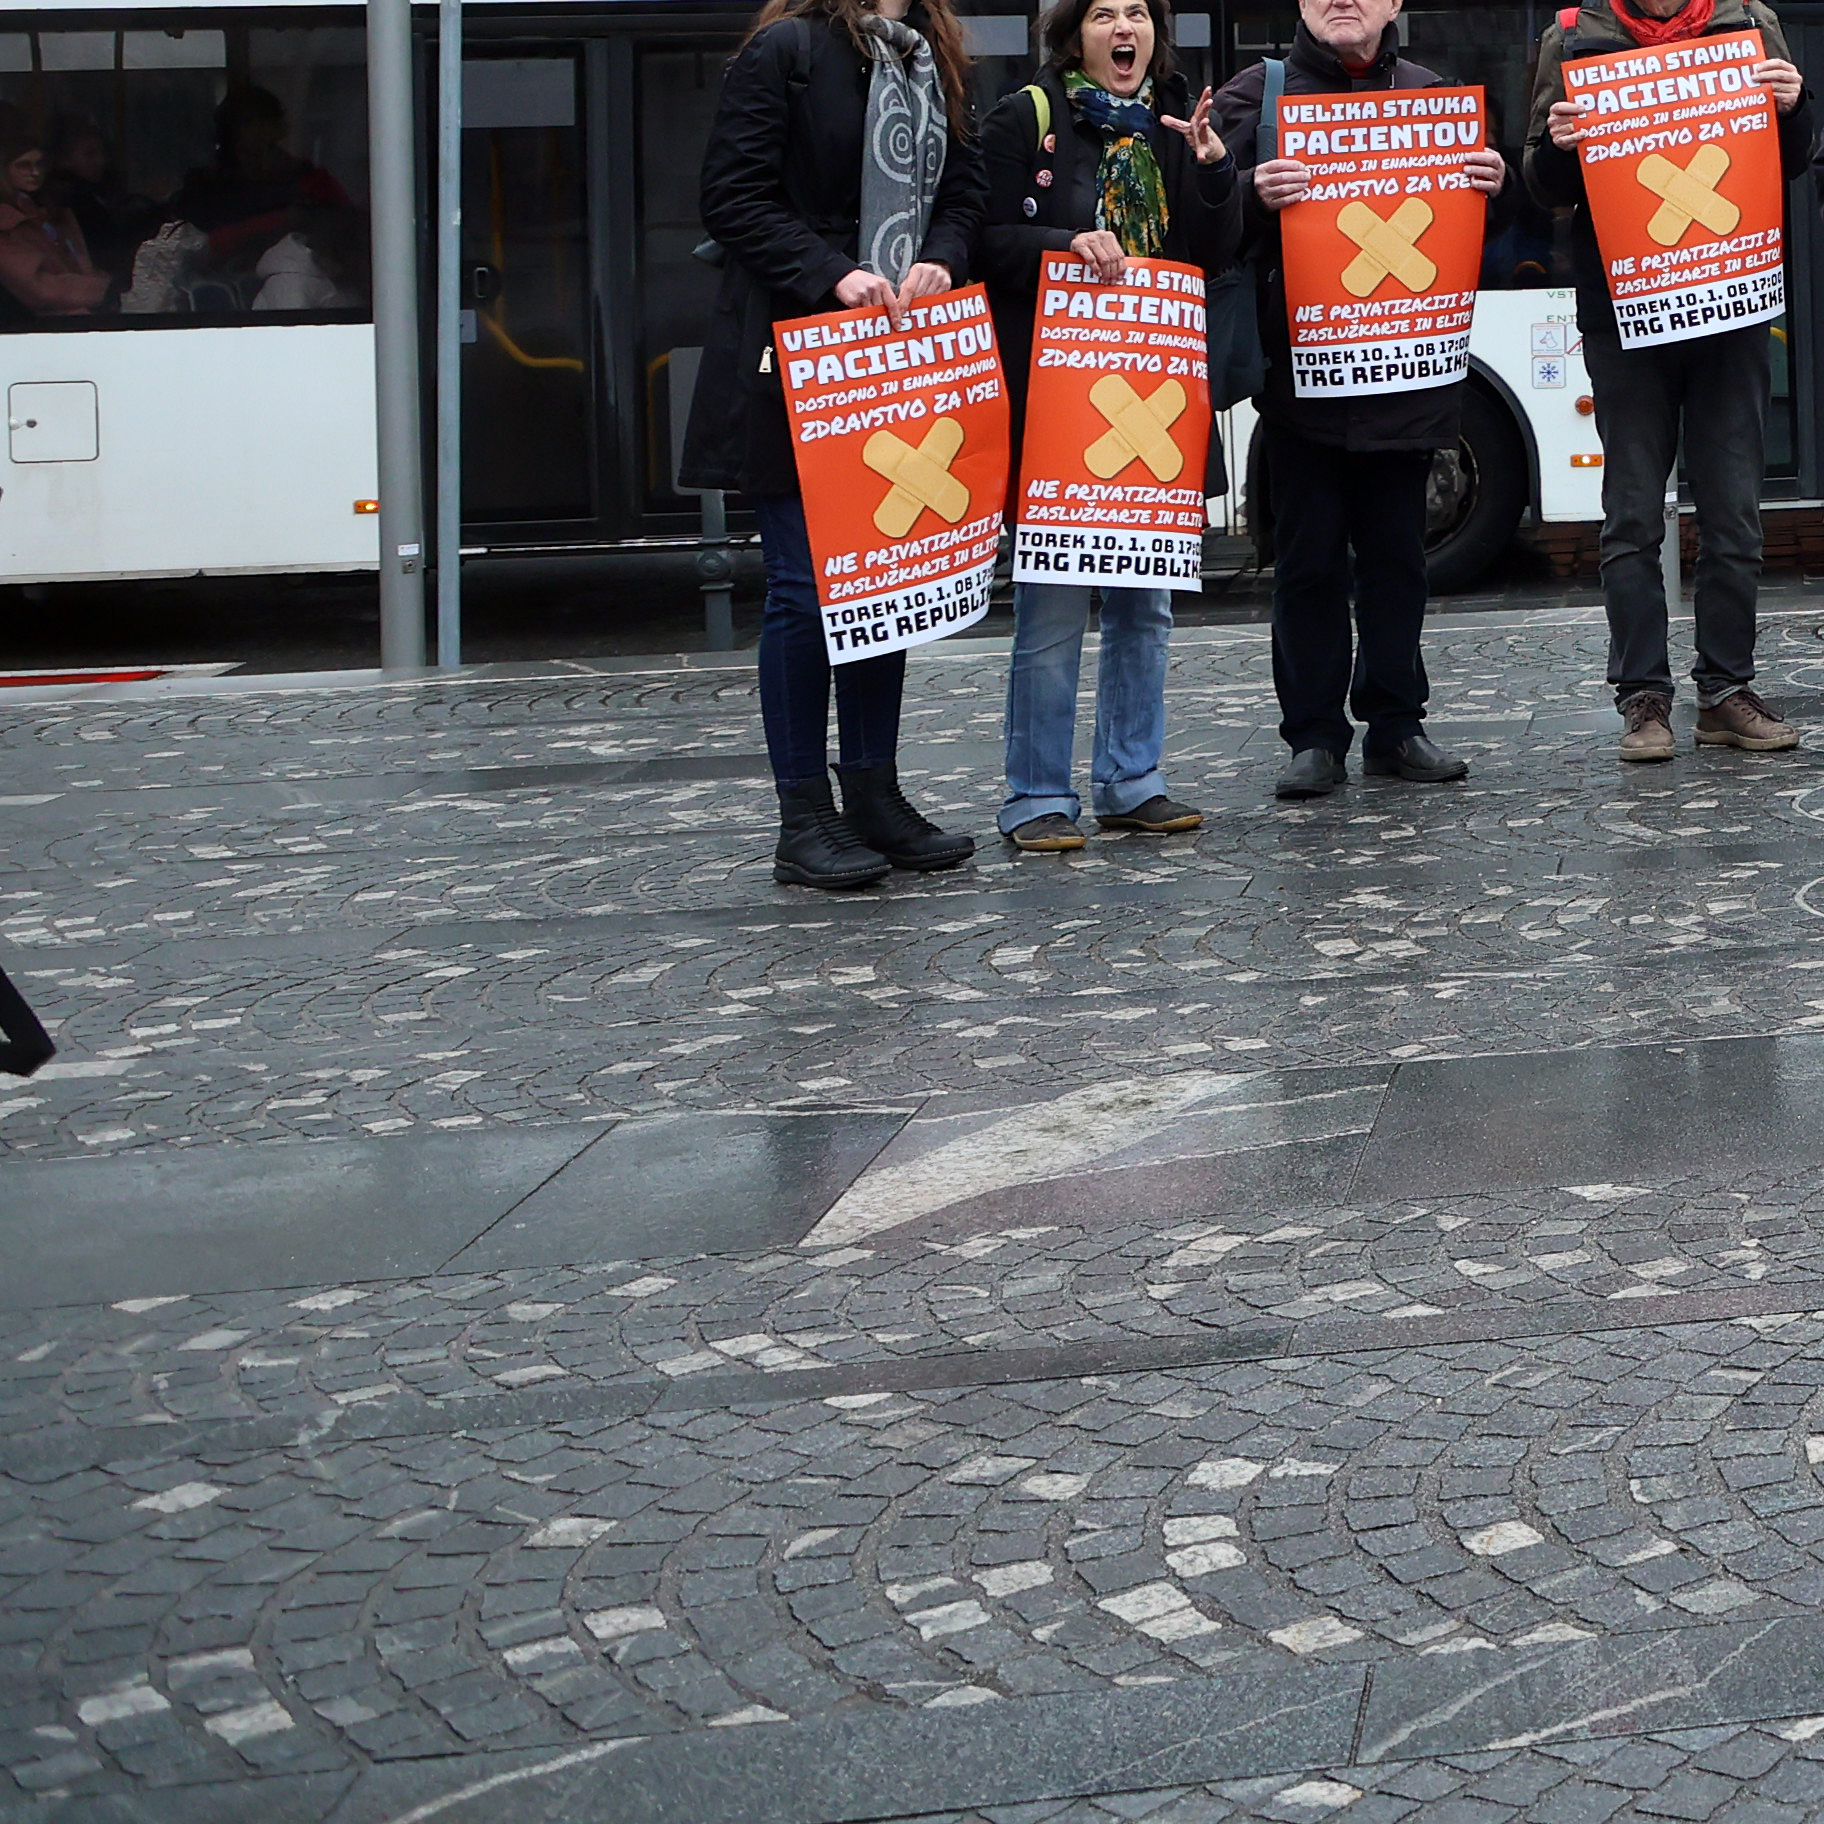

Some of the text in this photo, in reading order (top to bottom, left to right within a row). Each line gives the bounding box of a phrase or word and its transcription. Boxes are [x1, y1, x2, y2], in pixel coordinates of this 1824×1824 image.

[1568, 39, 1757, 88] VELIKA STAVKA
[1574, 63, 1761, 119] PACIENTOV
[1653, 112, 1669, 125] IN
[1673, 93, 1767, 121] ENAKOPRAVNO
[1282, 95, 1477, 124] VELIKA STAVKA
[1284, 121, 1479, 157] PACIENTOV
[1584, 112, 1768, 164] ZDRAVSTVO ZA VSE!
[1305, 162, 1356, 176] STOPNO
[1360, 159, 1377, 172] IN
[1300, 172, 1471, 202] DRAVSTVO ZA VSE
[1611, 227, 1781, 276] NE PRIVATIZACIJI ZA
[1047, 262, 1152, 287] VELKA
[1616, 263, 1720, 296] ZASLUŽKARJE
[1724, 258, 1741, 273] IN
[1295, 290, 1475, 323] NE PRIVATIZACIJI ZA
[1617, 270, 1782, 318] TOREK 10. 1. OB 17:00
[782, 294, 987, 352] VELIKA STAVKA
[1297, 319, 1410, 343] ZASLUŽKARJE
[1414, 318, 1433, 332] IN
[1620, 287, 1784, 338] TRG REPUBLIKE
[1041, 326, 1121, 343] DOSTOPNO
[1125, 331, 1145, 344] IN
[1294, 334, 1470, 366] TOREK 10. 1. OB 17:00
[788, 322, 993, 390] PACIENTOV
[1037, 348, 1162, 372] ZDRAVSTVO
[1166, 356, 1189, 375] ZA
[1296, 351, 1468, 387] TRG REPUBLIKE
[795, 356, 997, 414] DOSTOPNO IN ENAKOPRAVNO
[800, 378, 999, 443] ZDRAVSTVO ZA VSE!
[1027, 479, 1060, 499] NE
[1064, 483, 1197, 506] PRIVATIZACIJI
[1025, 501, 1152, 524] ZASLUŽKARJE
[1155, 509, 1174, 525] IN
[824, 552, 858, 577] NE
[865, 516, 991, 569] PRIVATIZACIJI
[1019, 531, 1085, 549] TOREK
[1091, 535, 1123, 551] 10.
[1130, 537, 1146, 552] 1.
[1151, 538, 1174, 553] OB
[828, 555, 950, 600] ZASLUŽKARJE
[953, 549, 969, 567] IN
[1018, 550, 1202, 579] TRG REPUBLIK
[826, 598, 898, 627] TOREK
[904, 591, 933, 611] 10.
[937, 587, 951, 602] 1.
[954, 576, 973, 595] OB
[829, 622, 889, 651] TRG
